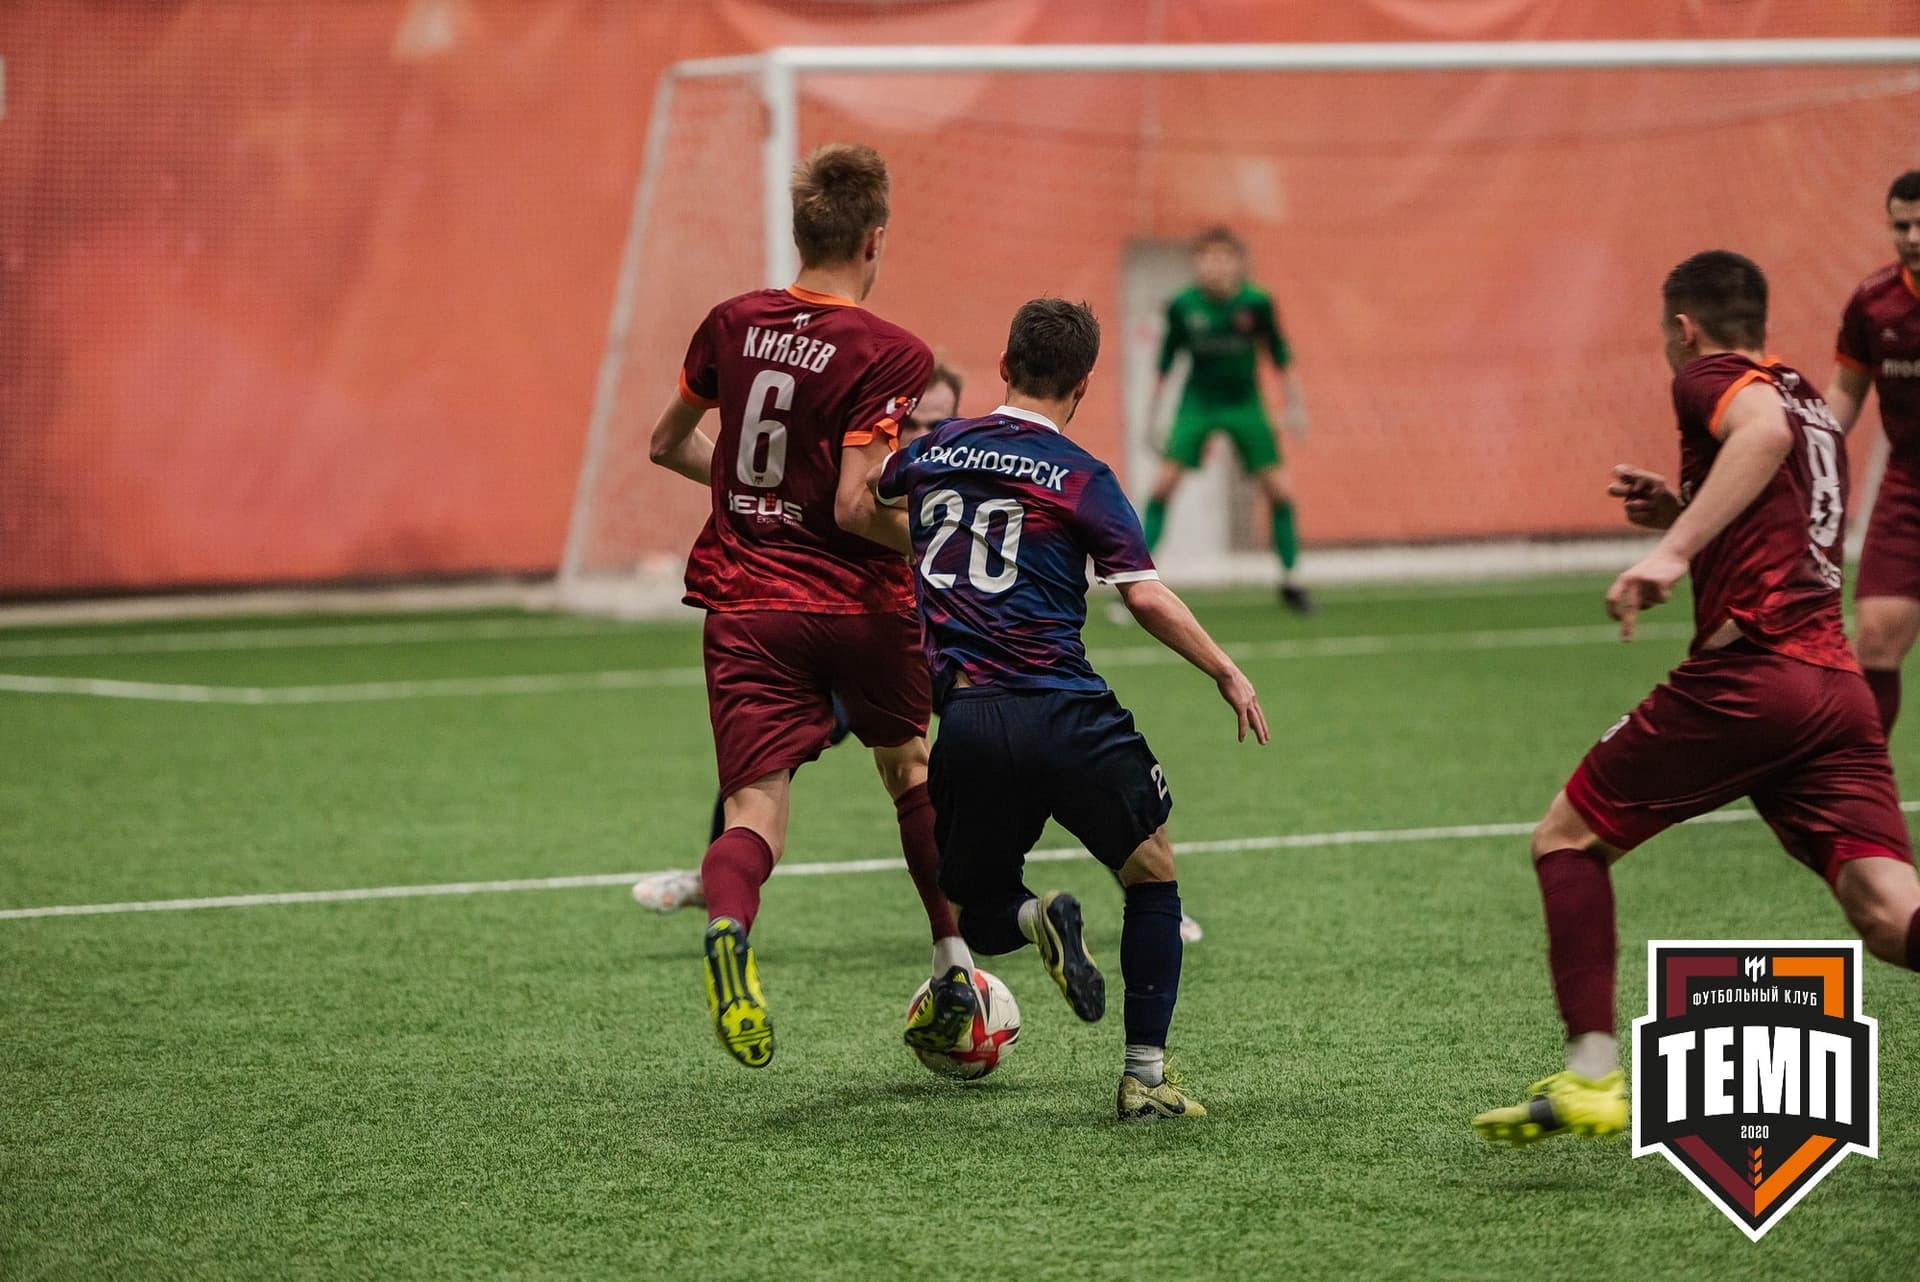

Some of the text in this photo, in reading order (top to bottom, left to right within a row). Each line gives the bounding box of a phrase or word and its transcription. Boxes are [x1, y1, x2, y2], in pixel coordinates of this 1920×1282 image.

[742, 326, 837, 374] КНЯЗЕВ
[736, 369, 796, 488] 6
[920, 489, 1025, 594] 20
